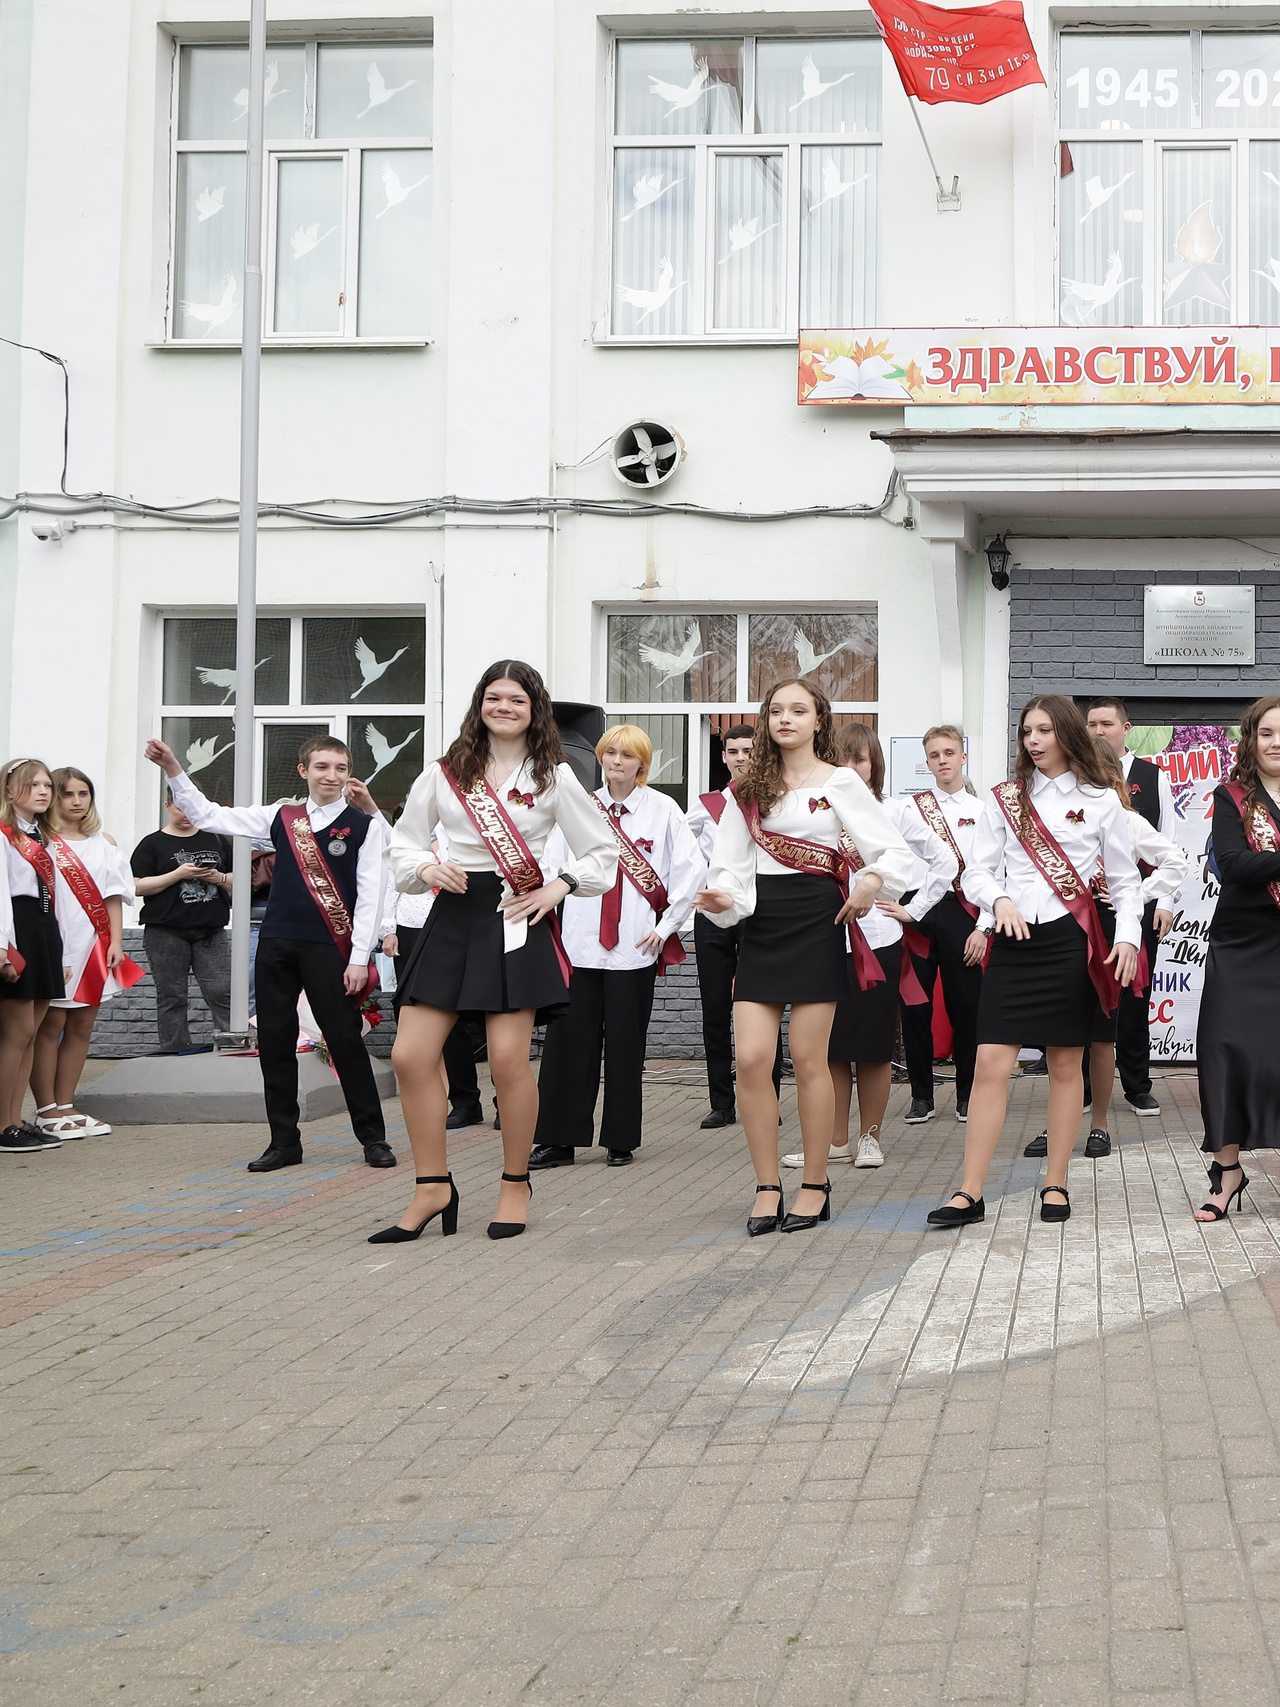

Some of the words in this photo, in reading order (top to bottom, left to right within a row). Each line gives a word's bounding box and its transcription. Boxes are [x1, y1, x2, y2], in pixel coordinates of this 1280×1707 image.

[924, 67, 951, 90] 79
[1066, 67, 1179, 108] 1945
[925, 336, 1252, 393] ЗДРАВСТВУЙ,
[1155, 648, 1207, 657] «ШКОЛА
[1210, 648, 1225, 657] №
[1228, 648, 1245, 657] 75»
[53, 840, 92, 900] Выпускница
[627, 860, 663, 893] 2025
[1044, 860, 1085, 901] 2025
